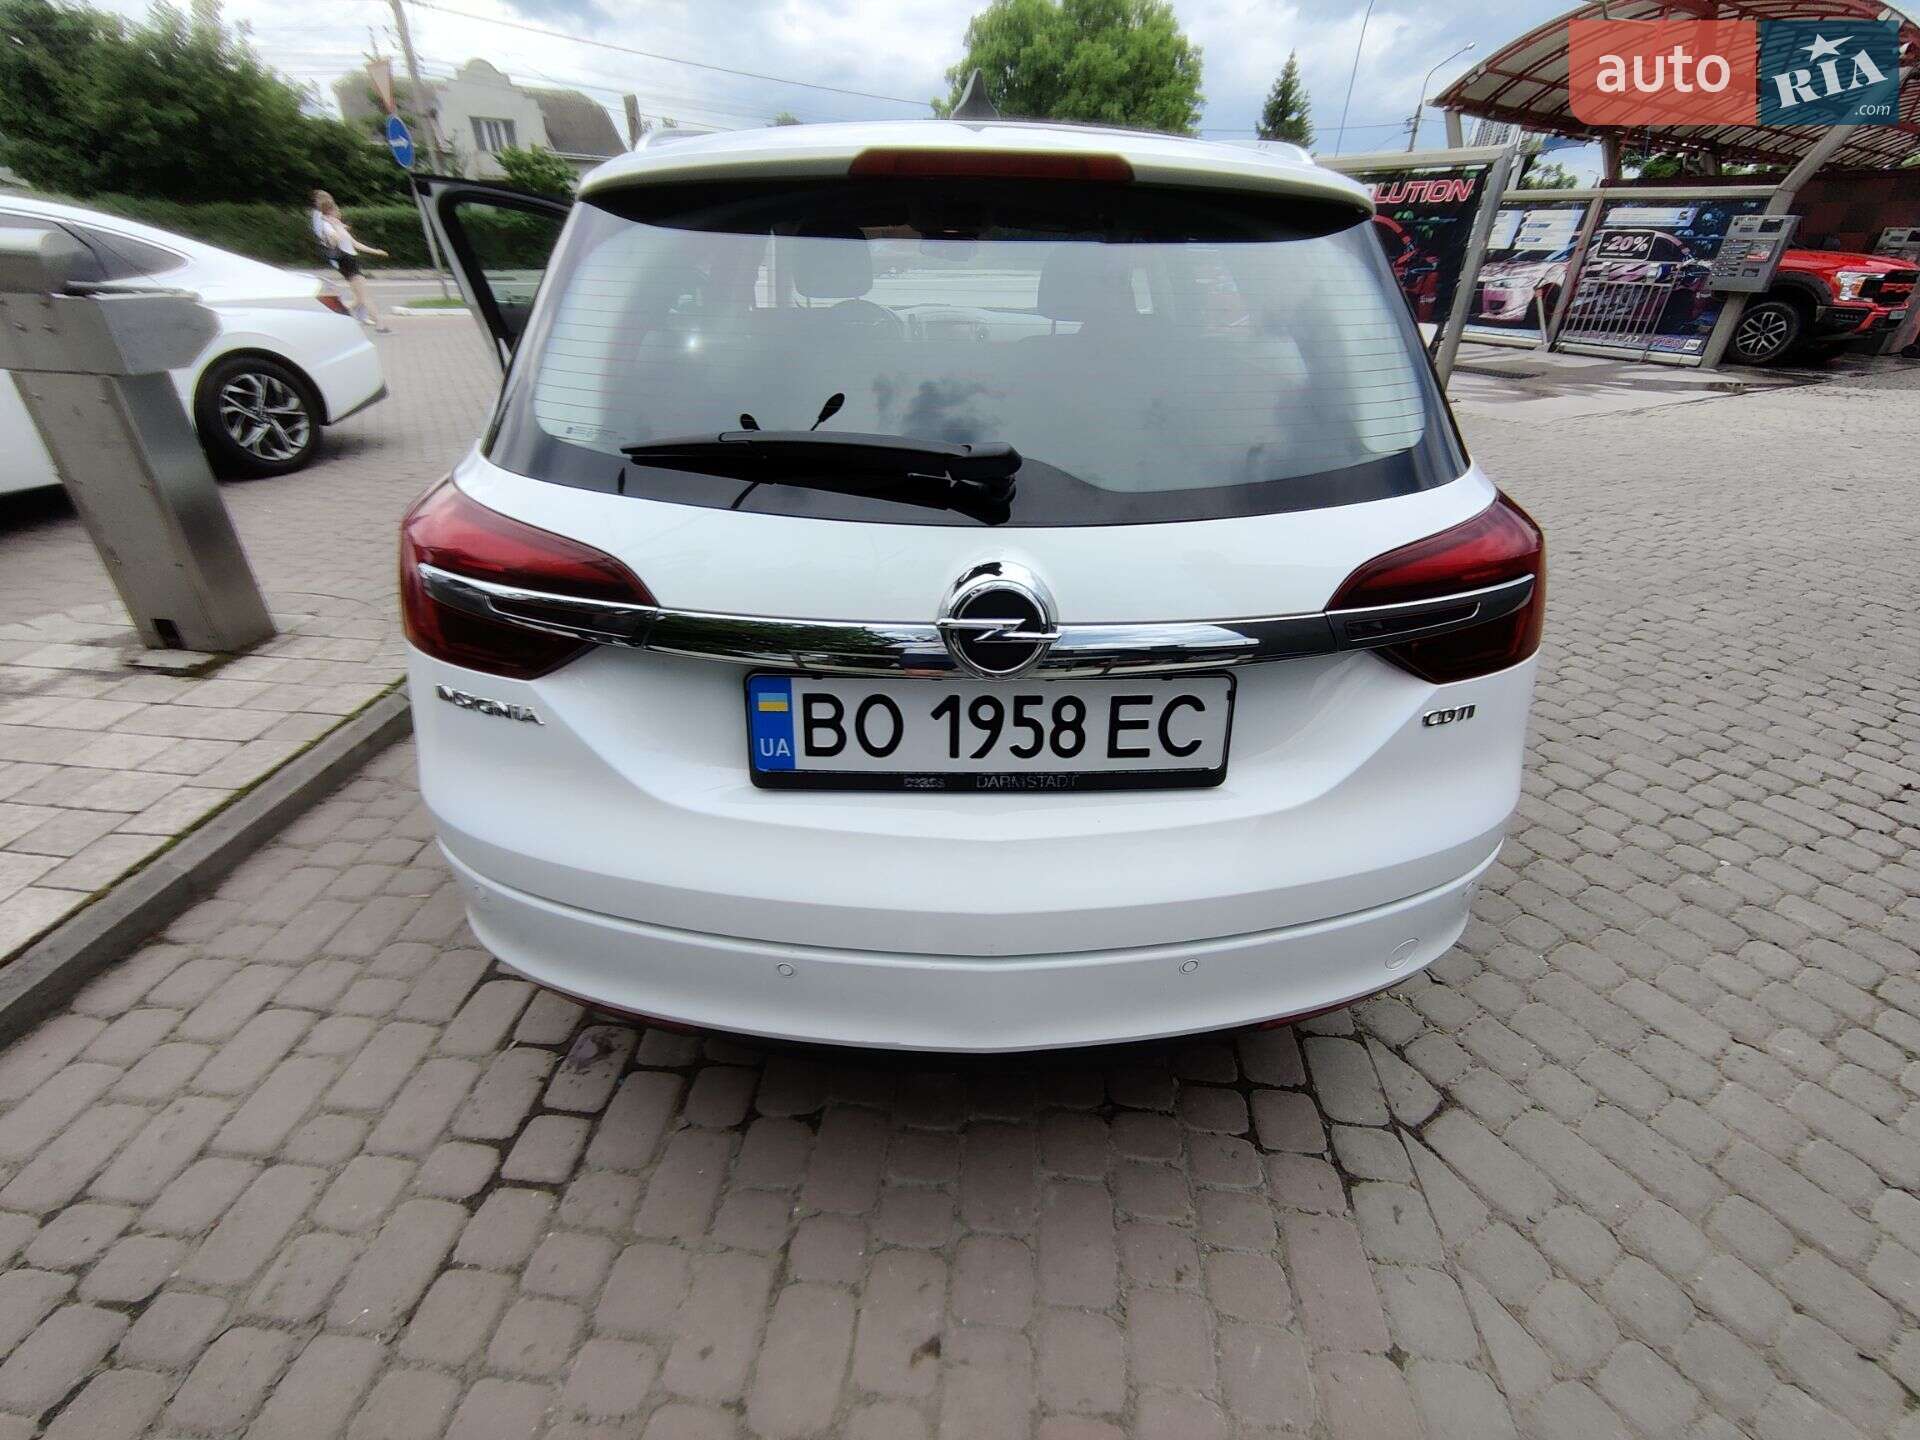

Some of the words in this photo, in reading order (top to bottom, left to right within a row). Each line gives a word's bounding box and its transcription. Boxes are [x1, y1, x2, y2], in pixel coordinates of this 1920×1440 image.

[1367, 178, 1476, 204] LUTION
[1602, 235, 1650, 252] -20%
[802, 692, 904, 757] BO
[930, 693, 1086, 759] 1958
[1107, 694, 1206, 758] EC
[760, 737, 791, 757] UA
[976, 774, 1080, 789] DARMSTADT
